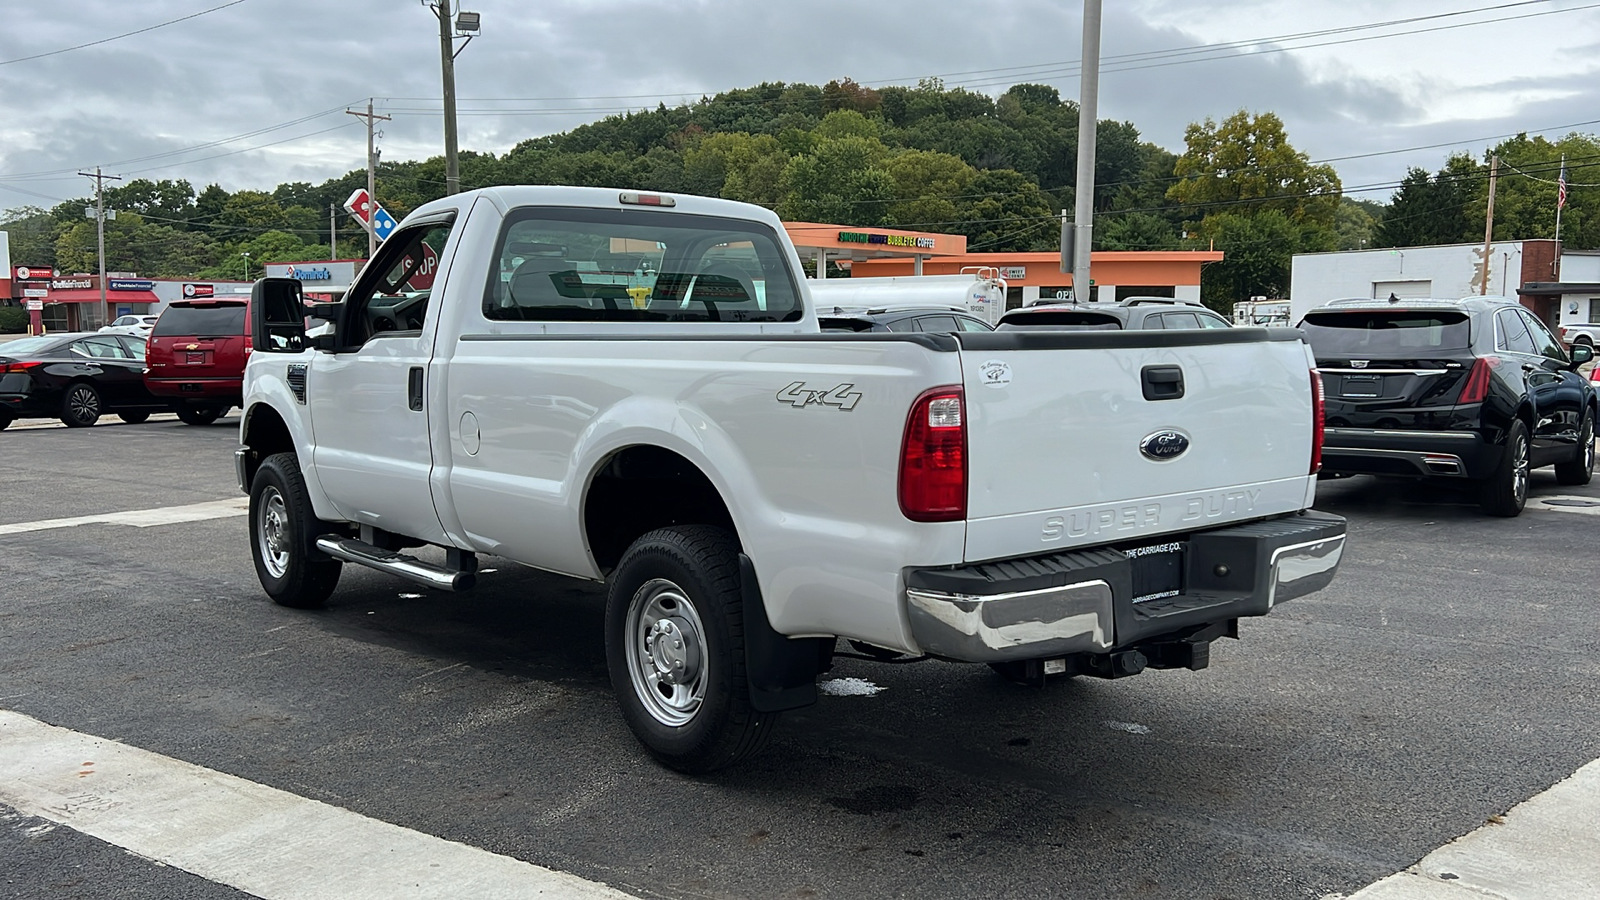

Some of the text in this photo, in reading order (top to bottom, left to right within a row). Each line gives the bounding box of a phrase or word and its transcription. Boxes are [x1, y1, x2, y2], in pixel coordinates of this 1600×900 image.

[839, 232, 868, 243] SMOOTHIE
[917, 237, 935, 248] COFFEE
[294, 267, 331, 280] Domino's
[405, 256, 435, 276] SOP
[1056, 290, 1073, 300] OPE
[776, 381, 863, 411] 4x4
[1041, 489, 1261, 542] SUPER DUTY
[1126, 542, 1181, 559] THE CARRIAGE CO.
